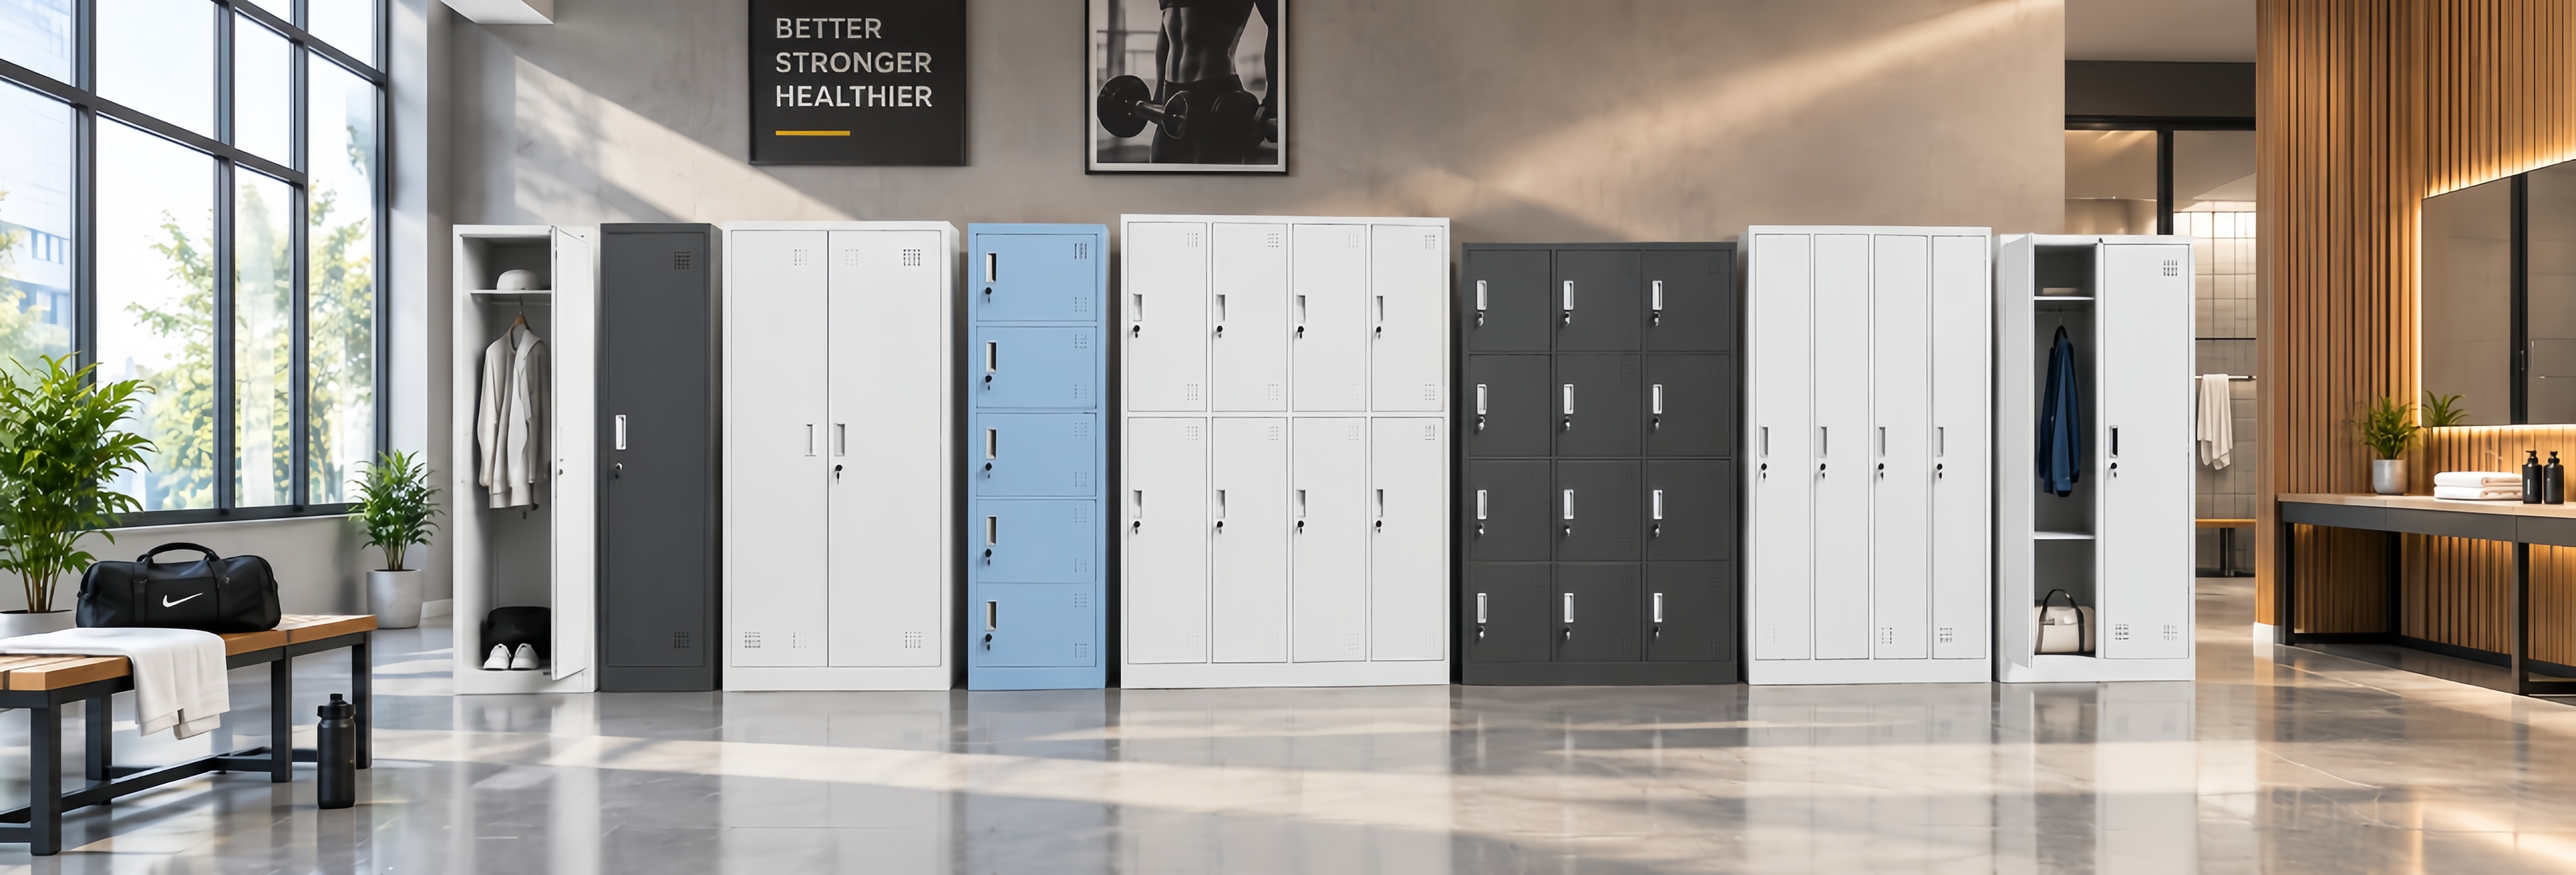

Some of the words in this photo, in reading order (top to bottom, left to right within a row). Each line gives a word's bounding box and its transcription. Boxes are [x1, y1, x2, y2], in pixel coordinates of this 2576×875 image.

[777, 18, 881, 38] BETTER
[776, 52, 931, 72] STRONGER
[777, 85, 932, 107] HEALTHIER
